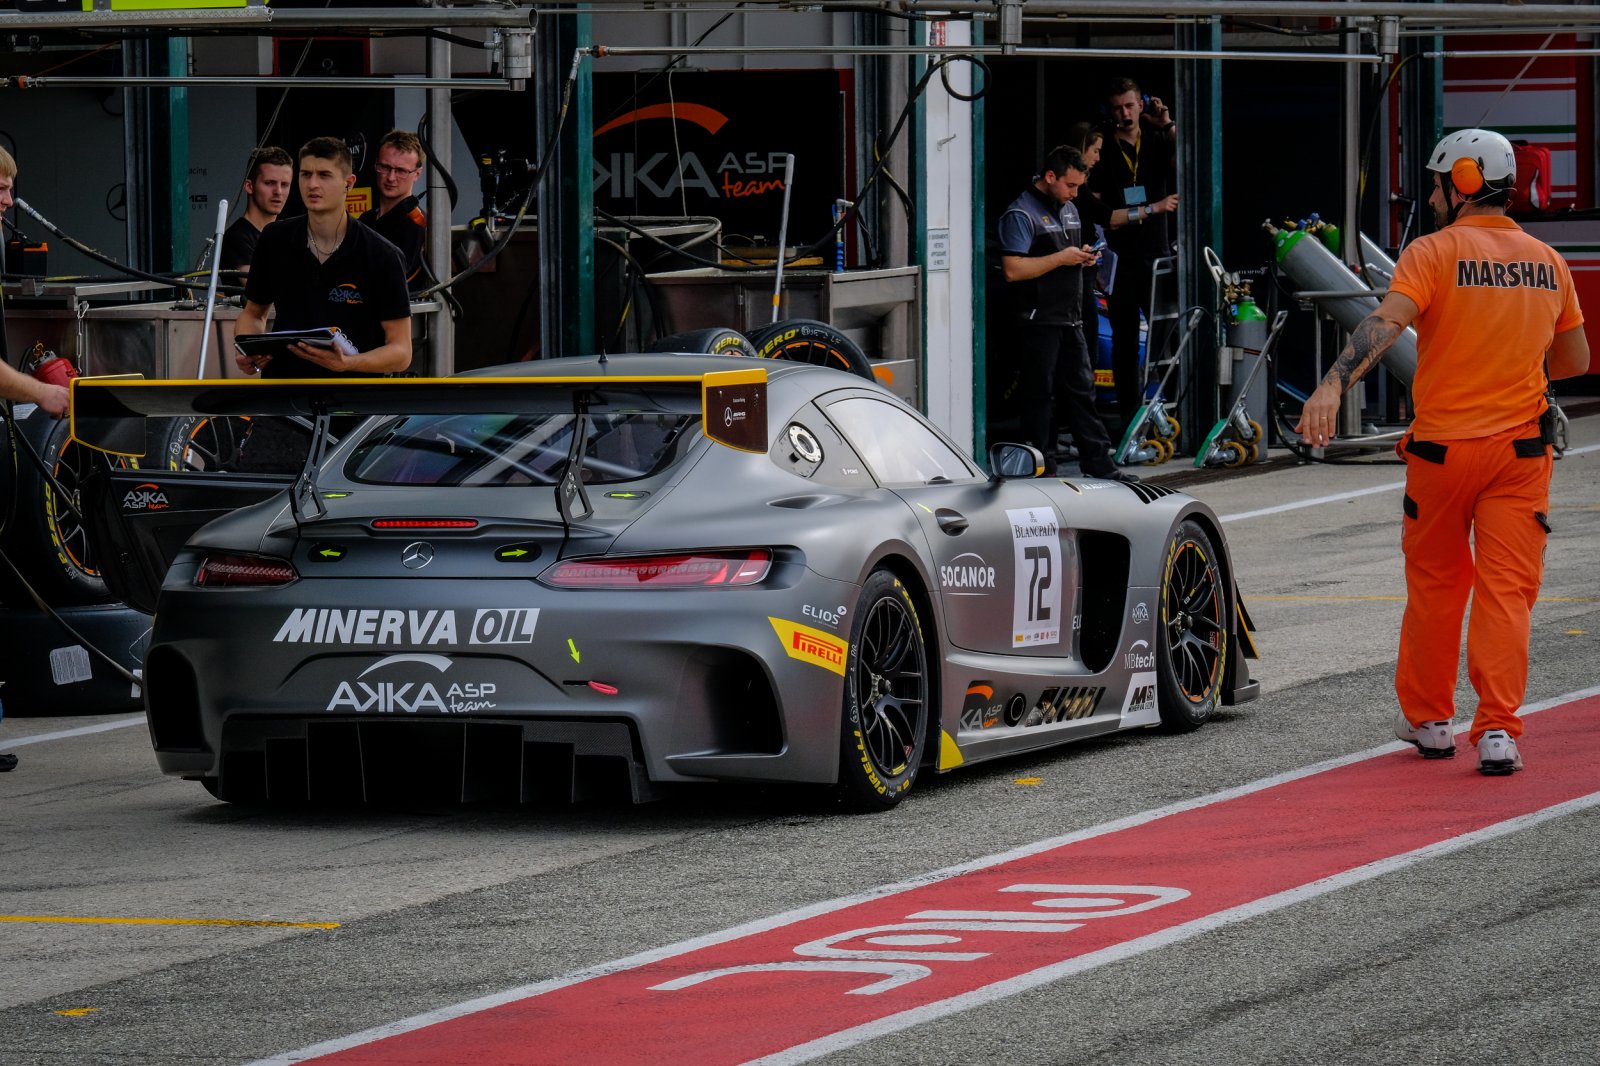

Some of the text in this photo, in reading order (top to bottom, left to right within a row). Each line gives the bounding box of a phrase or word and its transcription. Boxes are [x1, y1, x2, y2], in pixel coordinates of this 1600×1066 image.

[717, 152, 788, 174] ASP
[721, 171, 786, 198] team
[1457, 260, 1559, 291] MARSHAL
[329, 288, 364, 299] AKKA
[714, 336, 742, 352] ZERO
[758, 328, 799, 358] ZERO
[123, 490, 169, 504] AKKA
[123, 500, 147, 508] ASP
[1013, 522, 1056, 538] BLANCPAIN
[941, 565, 996, 588] SOCANOR
[1024, 545, 1052, 622] 72
[802, 604, 840, 625] ELIOS
[272, 608, 538, 645] MINERVA OIL
[792, 630, 844, 666] PIRELLI
[1124, 652, 1155, 669] MBtech
[326, 681, 496, 713] AKKA ASP
[449, 697, 497, 714] team
[984, 704, 1003, 718] ASP
[853, 730, 889, 797] PIRELLI
